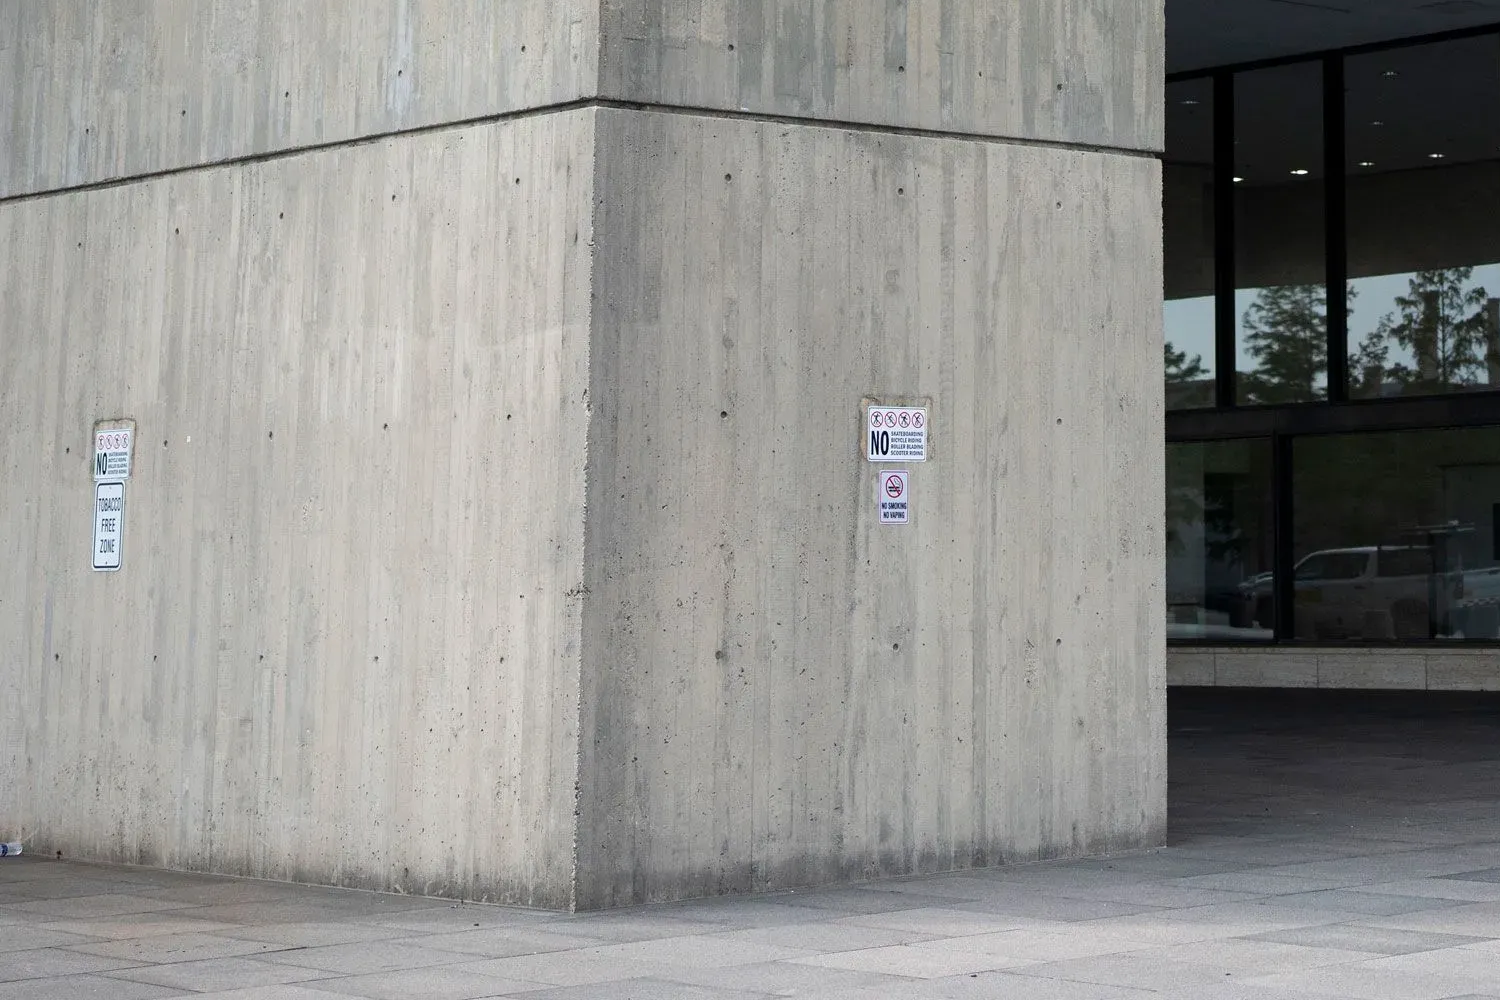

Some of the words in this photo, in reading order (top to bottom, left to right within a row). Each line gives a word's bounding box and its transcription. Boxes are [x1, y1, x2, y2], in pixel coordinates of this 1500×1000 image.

[871, 430, 889, 455] NO
[96, 452, 107, 475] NO
[99, 497, 121, 512] TOBACCO
[888, 502, 906, 510] SMOKING
[101, 518, 115, 532] FREE
[100, 539, 115, 553] ZONE
